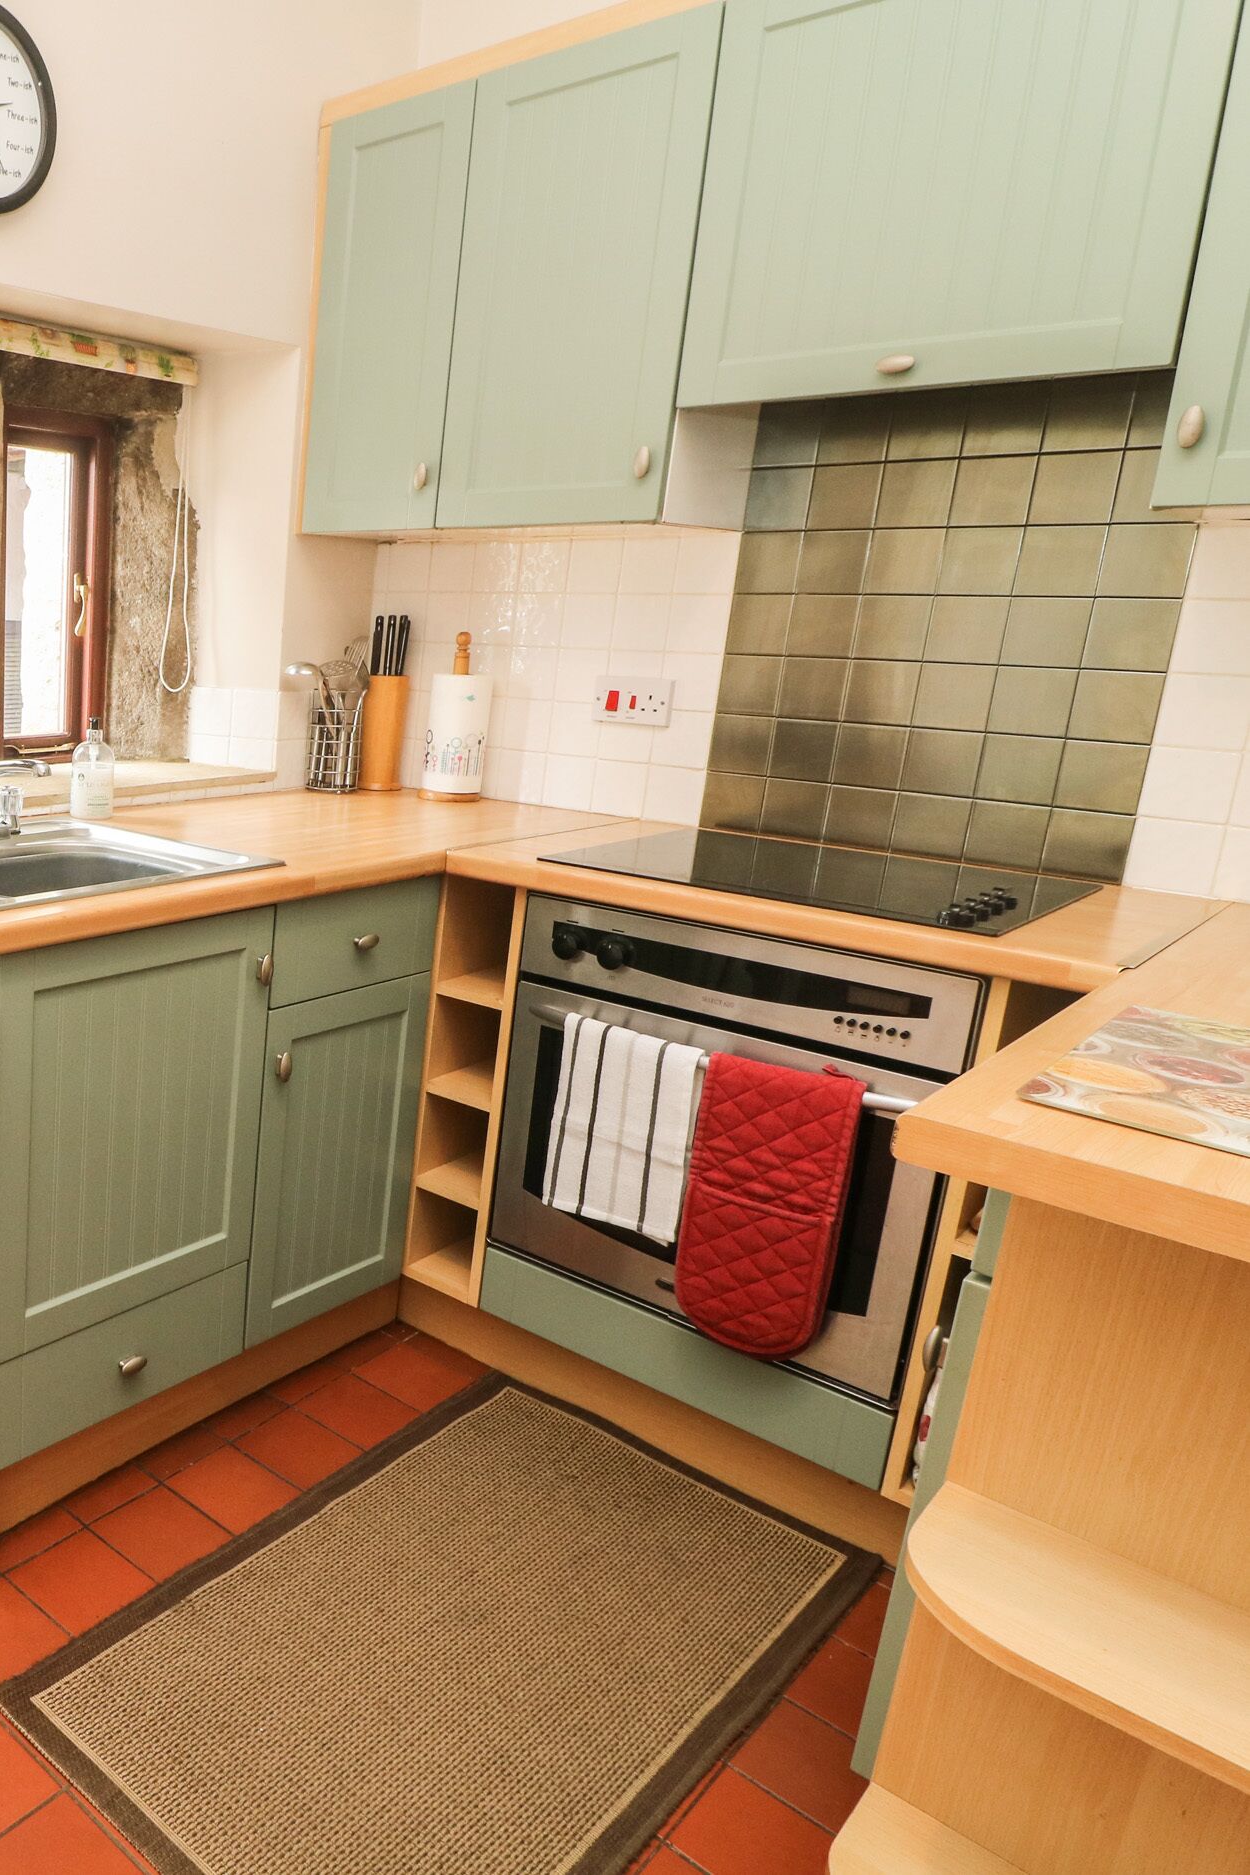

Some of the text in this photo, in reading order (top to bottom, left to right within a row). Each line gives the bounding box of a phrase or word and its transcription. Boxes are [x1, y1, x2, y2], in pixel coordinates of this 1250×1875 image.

[7, 77, 32, 91] Two-ish
[6, 109, 38, 125] Three-ish
[6, 140, 34, 155] Four-ish
